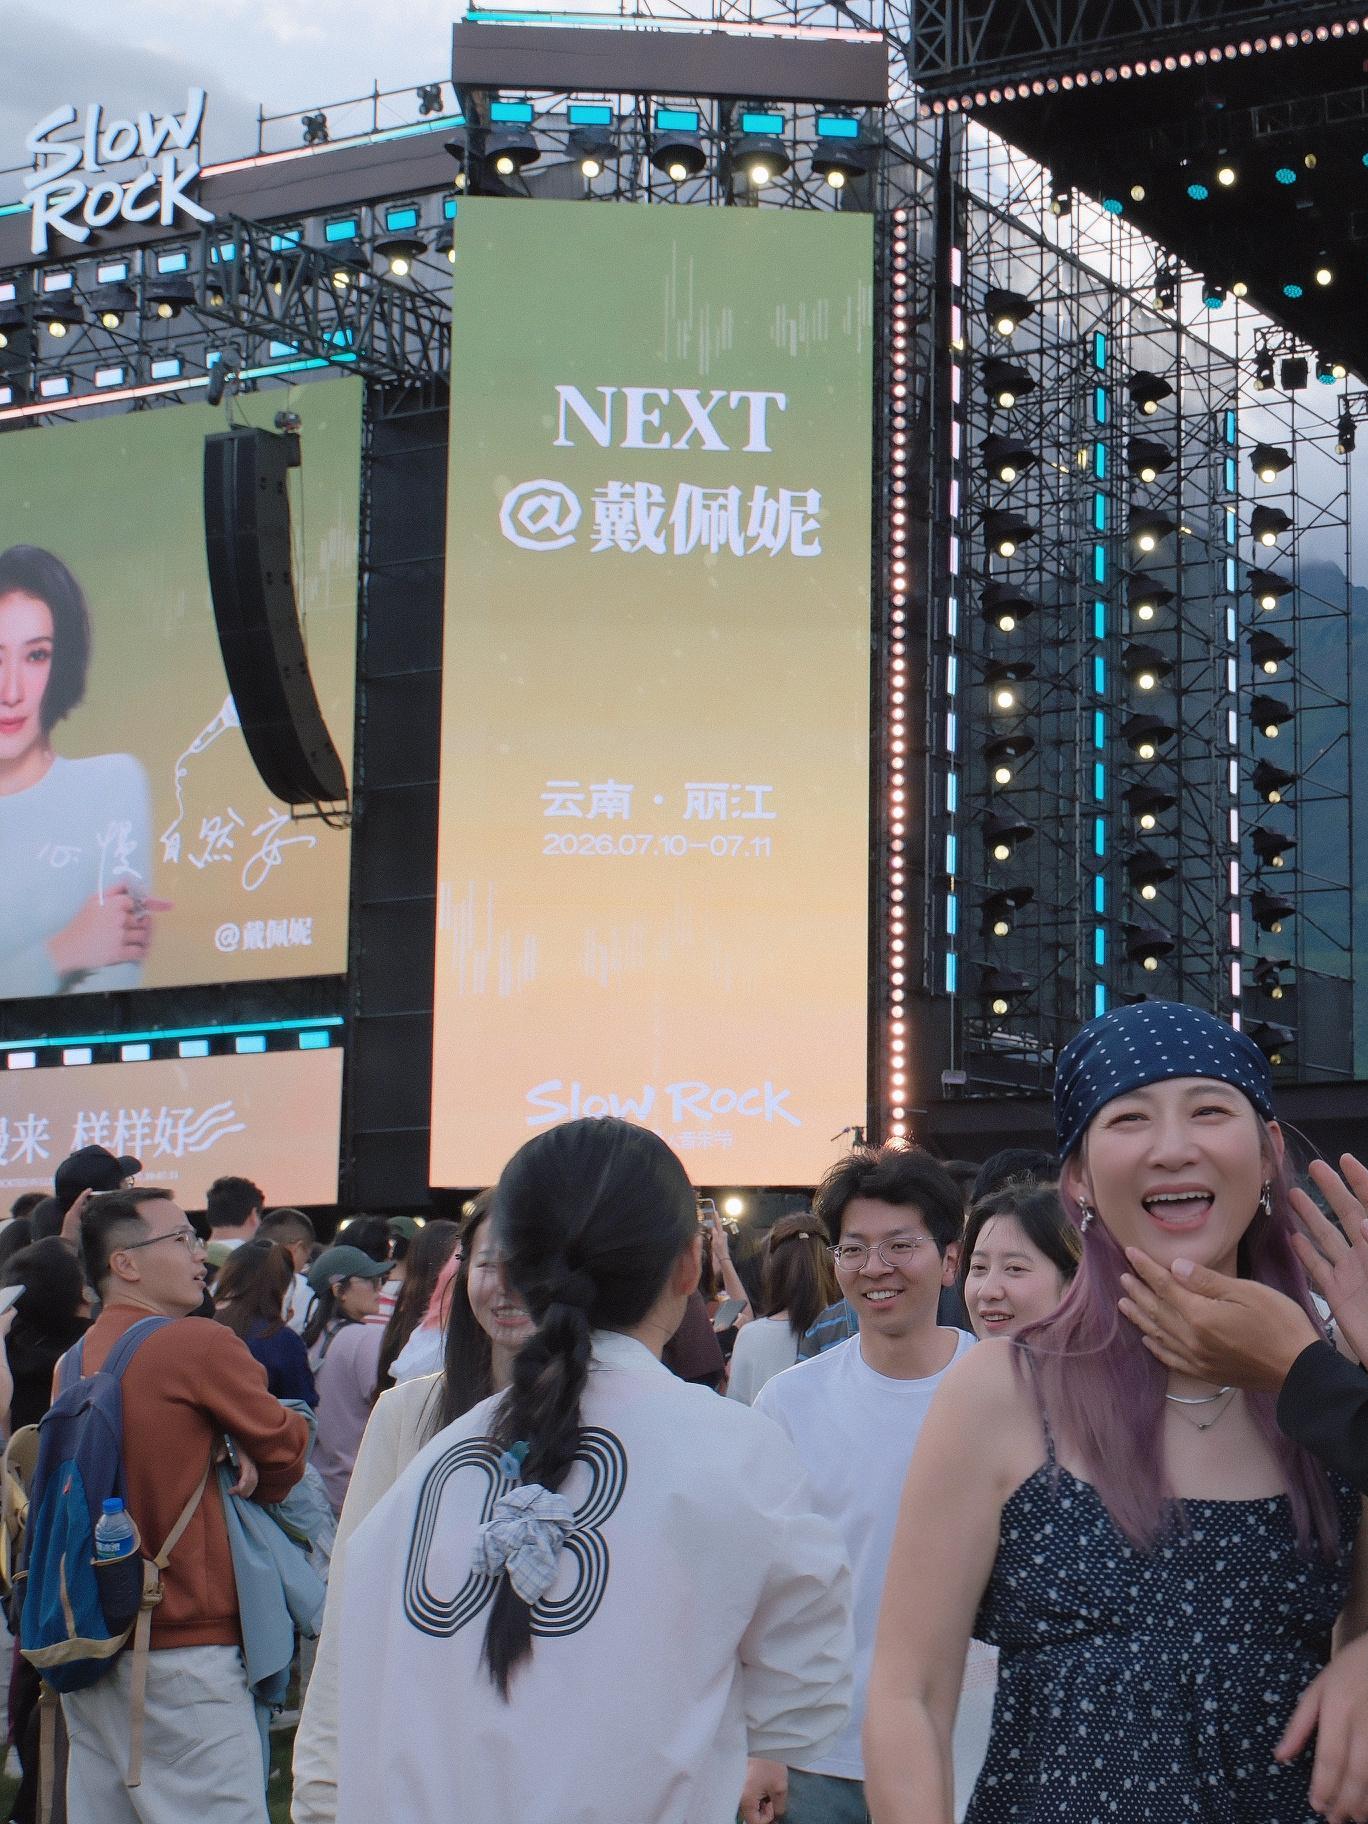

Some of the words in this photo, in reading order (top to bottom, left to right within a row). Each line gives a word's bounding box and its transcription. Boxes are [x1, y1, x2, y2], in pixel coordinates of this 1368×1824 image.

[553, 385, 787, 452] NEXT
[499, 478, 823, 557] @戴佩妮
[215, 917, 313, 952] @戴佩妮
